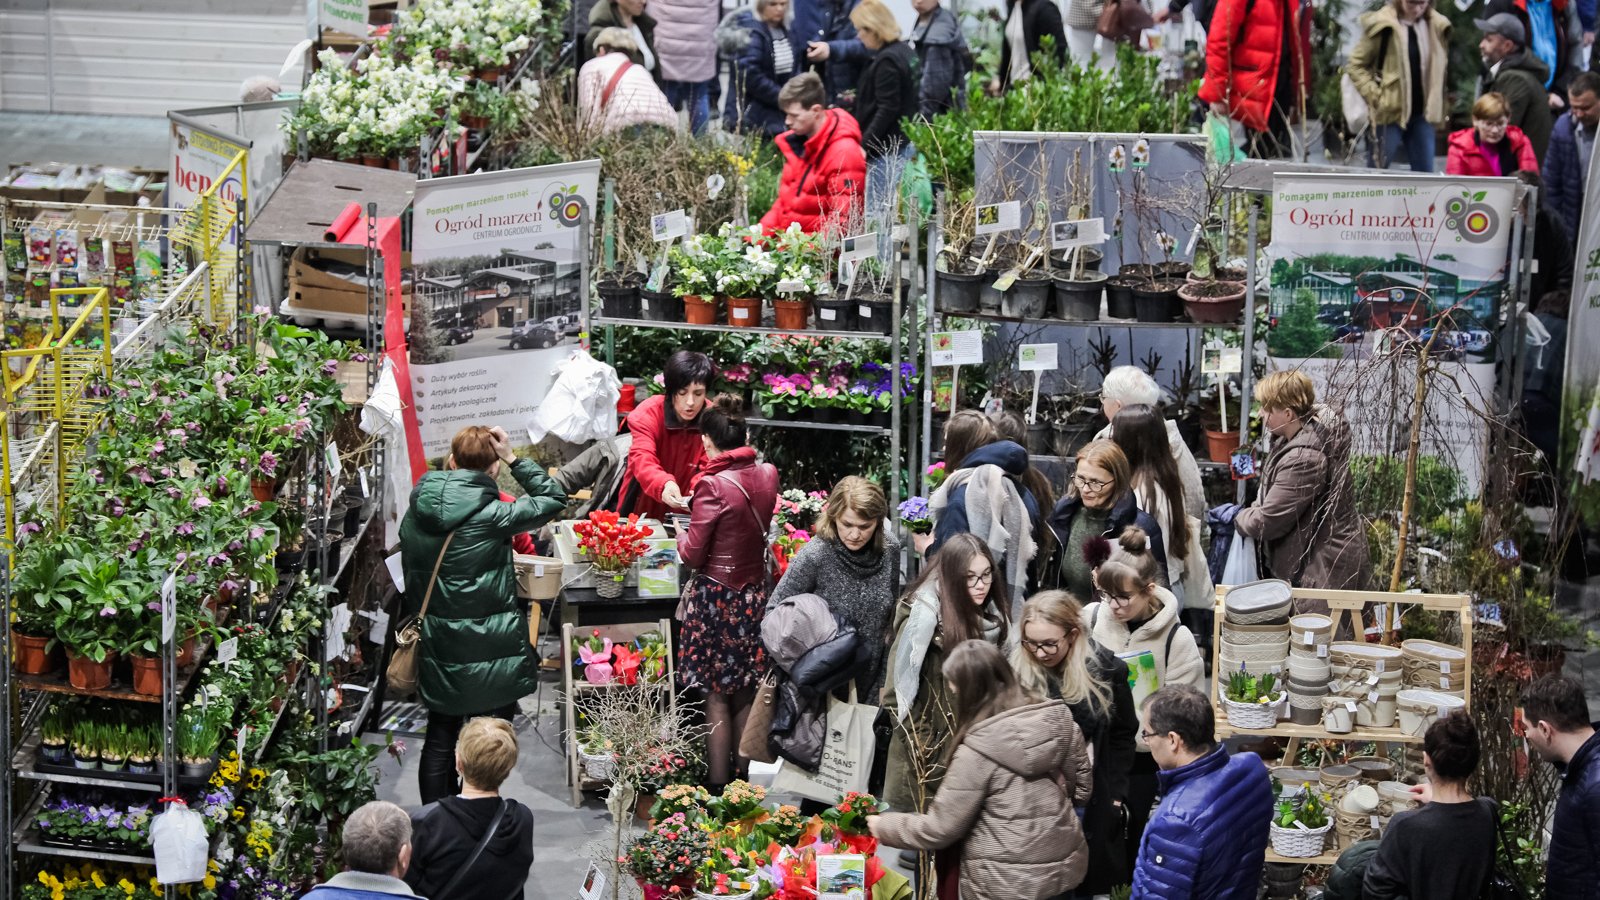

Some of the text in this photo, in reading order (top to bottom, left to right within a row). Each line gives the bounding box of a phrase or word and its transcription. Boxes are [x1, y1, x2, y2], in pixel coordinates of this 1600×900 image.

[426, 203, 464, 216] Pomagamy
[466, 195, 505, 208] marzeniom
[507, 188, 529, 201] rosnąć
[1279, 192, 1328, 203] Pomagamy
[1332, 189, 1384, 199] marzeniom
[1387, 186, 1418, 197] rosnąć
[435, 213, 483, 234] Ogród
[1289, 206, 1353, 229] Ogród
[473, 224, 542, 240] CENTRUM OGRODNICZE
[1340, 231, 1435, 242] CENTRUM OGRODNICZE
[431, 368, 487, 383] Duży wybór roślin
[430, 382, 498, 397] Artykuły dekoracyjne
[430, 395, 497, 411] Artykuły zoologiczne
[479, 406, 515, 418] zakładanie
